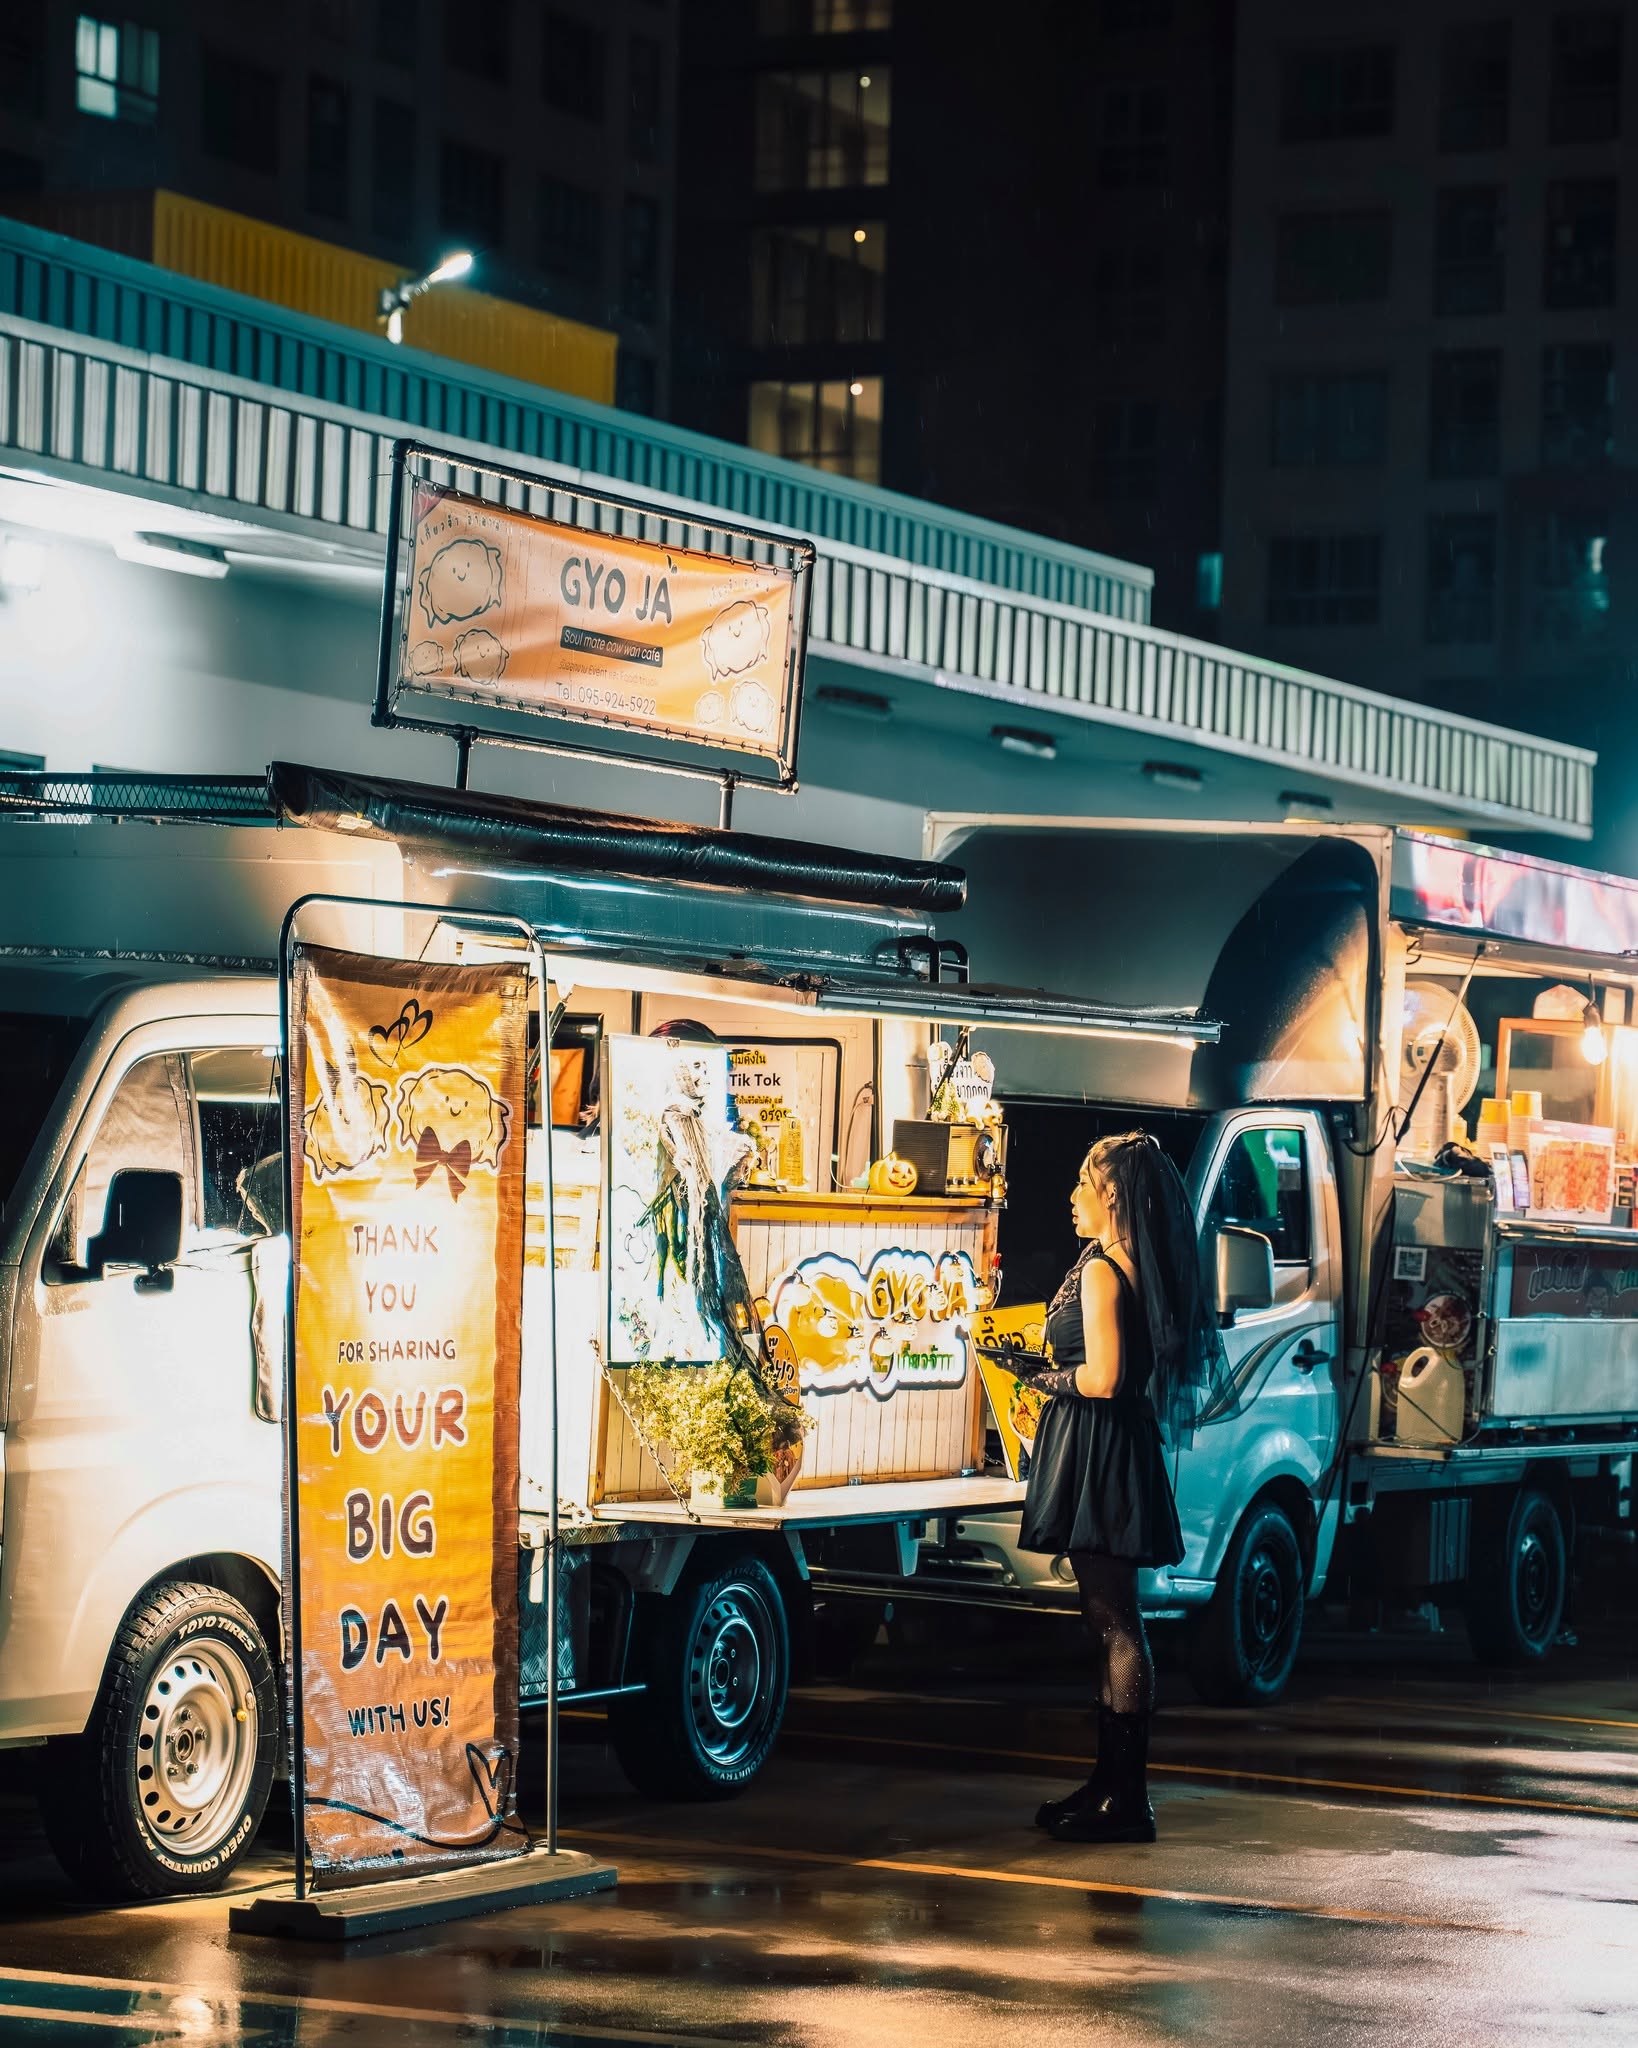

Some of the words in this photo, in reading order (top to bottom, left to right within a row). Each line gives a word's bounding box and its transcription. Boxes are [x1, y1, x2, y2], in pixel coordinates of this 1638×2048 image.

[560, 556, 626, 614] GYO
[564, 629, 584, 644] Soul
[584, 636, 606, 651] mate
[606, 641, 625, 654] cow
[641, 647, 661, 662] cafe
[588, 664, 608, 679] Event
[556, 681, 576, 701] Tel.
[578, 686, 656, 716] 095-924-5922
[729, 1072, 751, 1087] Tik
[754, 1072, 781, 1087] Tok
[353, 1224, 439, 1257] THANK
[365, 1280, 417, 1313] YOU
[338, 1340, 364, 1363] FOR
[369, 1338, 456, 1361] SHARING
[323, 1387, 465, 1453] YOUR
[345, 1491, 434, 1560] BIG
[178, 1615, 217, 1641] TOYO
[217, 1616, 257, 1653] TIRES
[340, 1597, 448, 1670] DAY
[346, 1702, 406, 1737] WITH
[412, 1695, 451, 1728] US!
[218, 1813, 253, 1863] OPEN
[155, 1853, 220, 1874] COUNTRY
